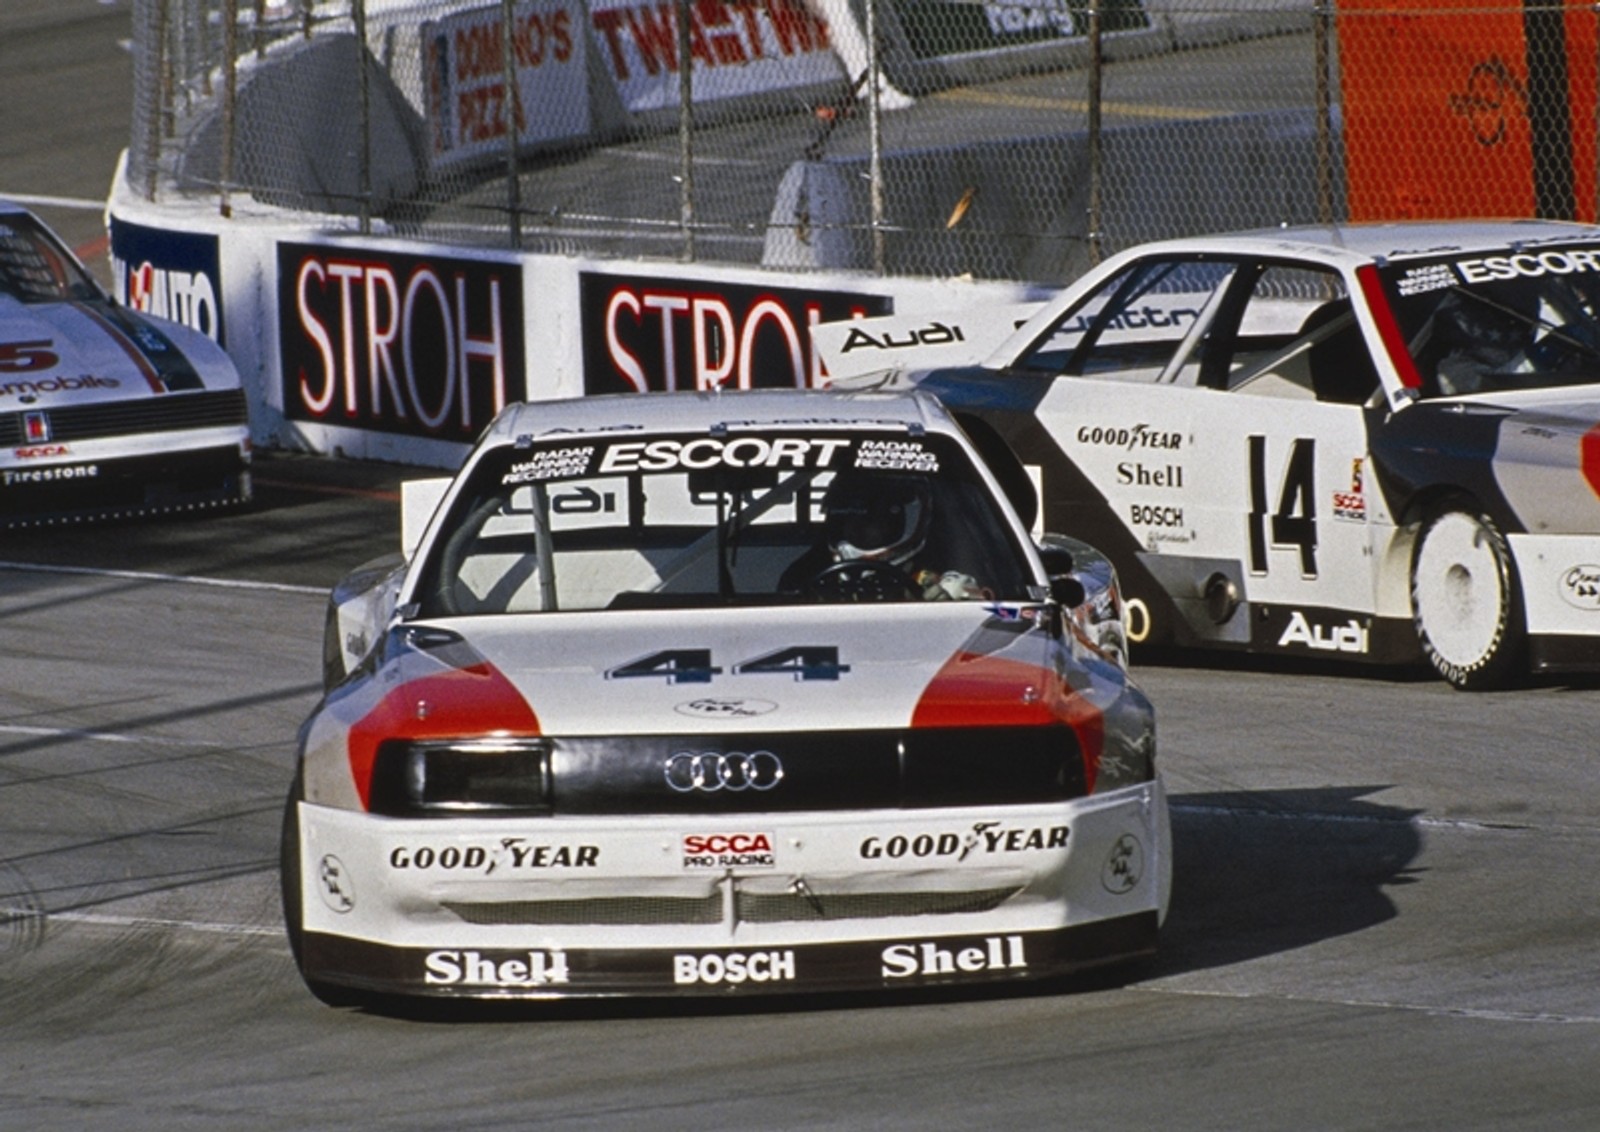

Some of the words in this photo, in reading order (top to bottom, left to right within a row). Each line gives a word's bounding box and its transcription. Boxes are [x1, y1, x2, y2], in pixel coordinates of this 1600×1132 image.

[456, 10, 572, 81] DOMNO'S
[1456, 250, 1600, 284] ESCOR
[297, 258, 506, 428] STROH
[841, 322, 965, 352] Audi
[533, 446, 595, 461] RADAR
[598, 438, 851, 473] ESCORT
[857, 448, 936, 462] WARNING
[861, 440, 922, 451] RADAR
[3, 465, 98, 486] Firestone
[502, 466, 585, 484] RECEIVER
[511, 456, 590, 474] WARNING
[854, 457, 940, 472] RECEIVER
[1117, 462, 1182, 488] Shell
[1130, 504, 1183, 527] BOSCH
[1247, 433, 1319, 580] 14
[1278, 611, 1368, 653] Audi
[604, 645, 851, 686] 44
[684, 834, 770, 853] SCCA
[684, 856, 715, 867] PRO
[718, 854, 774, 866] RACING
[425, 951, 568, 986] Shell
[674, 951, 796, 984] BOSCH
[881, 936, 1027, 978] Shell
